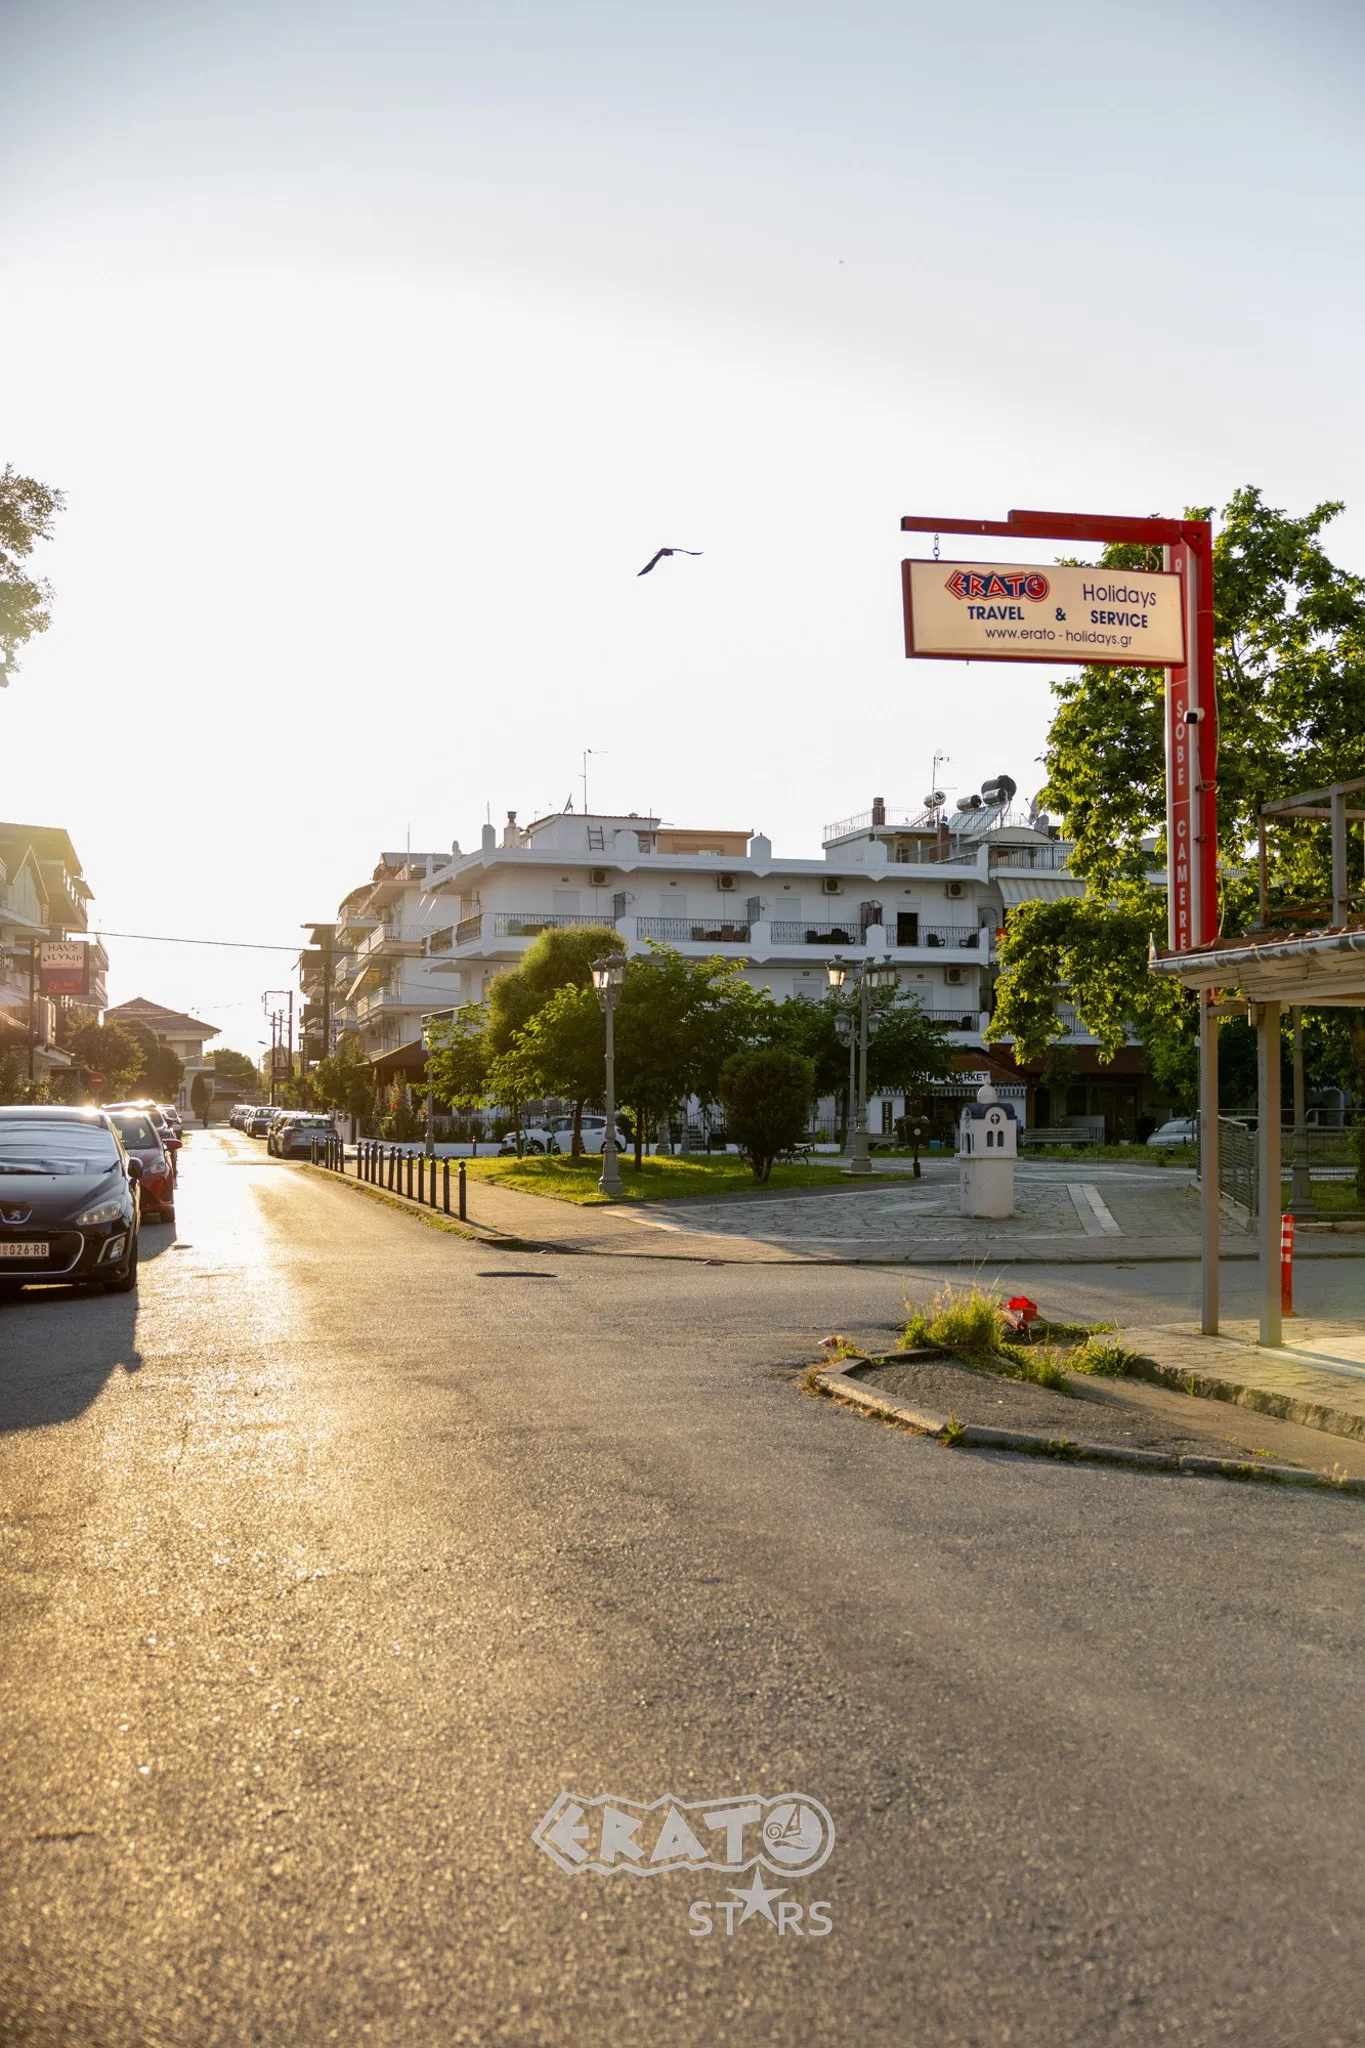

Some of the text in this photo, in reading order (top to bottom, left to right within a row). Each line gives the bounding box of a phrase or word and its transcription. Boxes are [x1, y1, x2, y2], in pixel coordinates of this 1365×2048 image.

[946, 570, 1157, 608] ERATO Holidays
[967, 605, 1148, 628] TRAVEL & SERVICE
[1175, 699, 1186, 786] SOBE
[1177, 820, 1188, 951] CAMERE
[48, 943, 78, 952] HAUS
